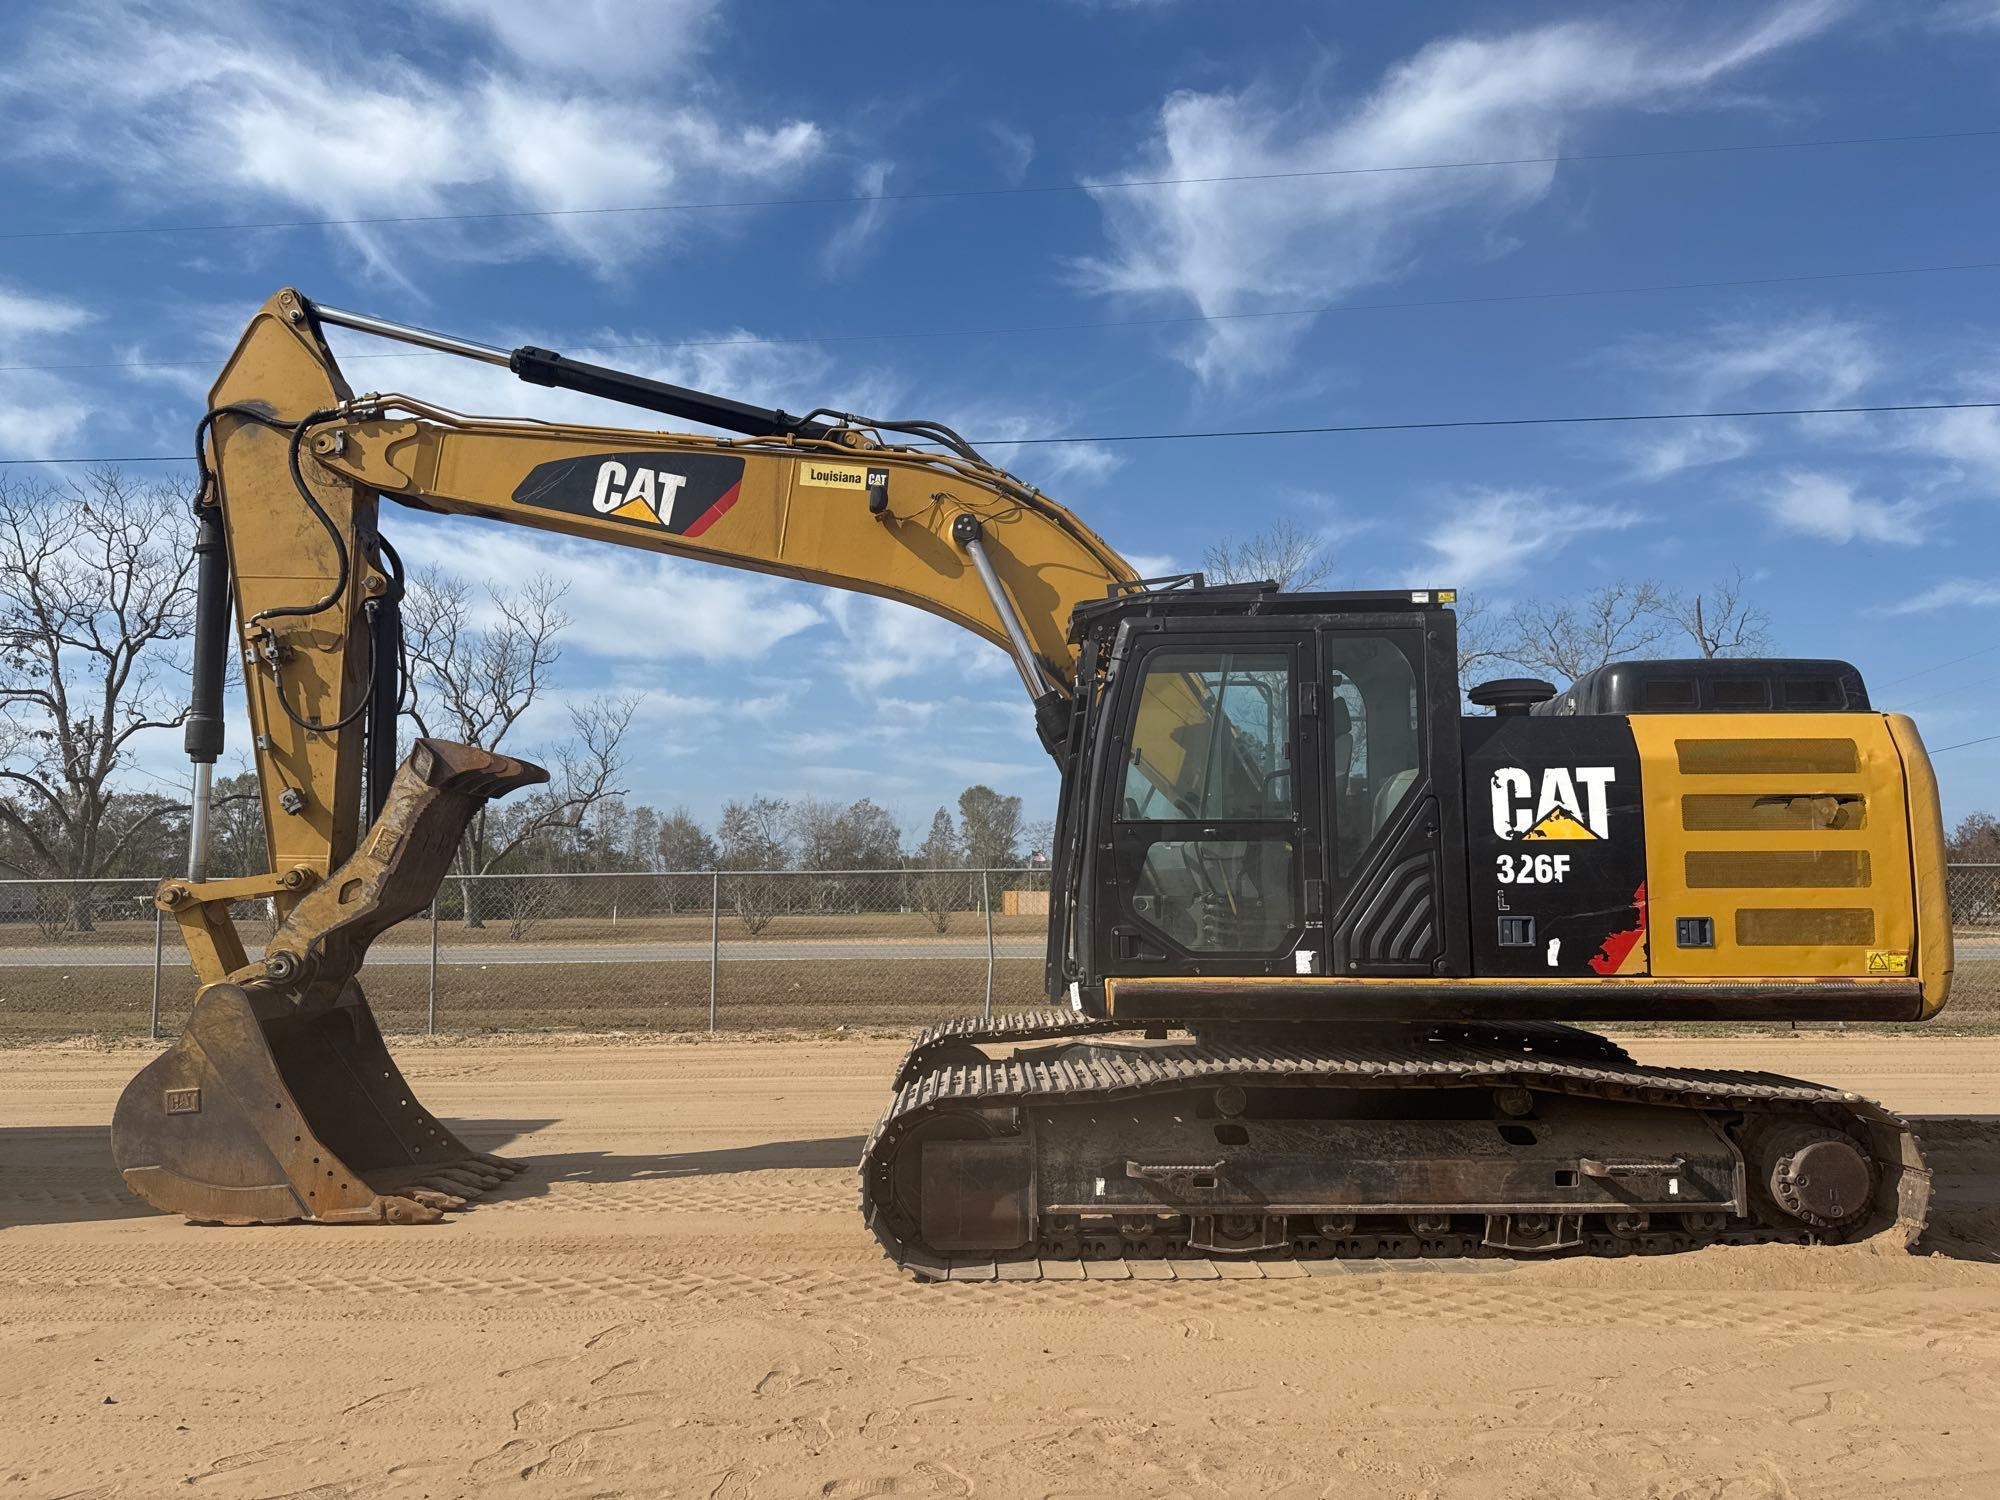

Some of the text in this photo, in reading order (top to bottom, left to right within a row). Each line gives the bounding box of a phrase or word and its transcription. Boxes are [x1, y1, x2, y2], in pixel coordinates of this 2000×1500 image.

[810, 468, 887, 486] Louisiana CAT
[592, 460, 687, 526] CAT
[1490, 766, 1616, 841] CAT
[1496, 854, 1571, 884] 326F
[168, 1092, 198, 1112] CAT
